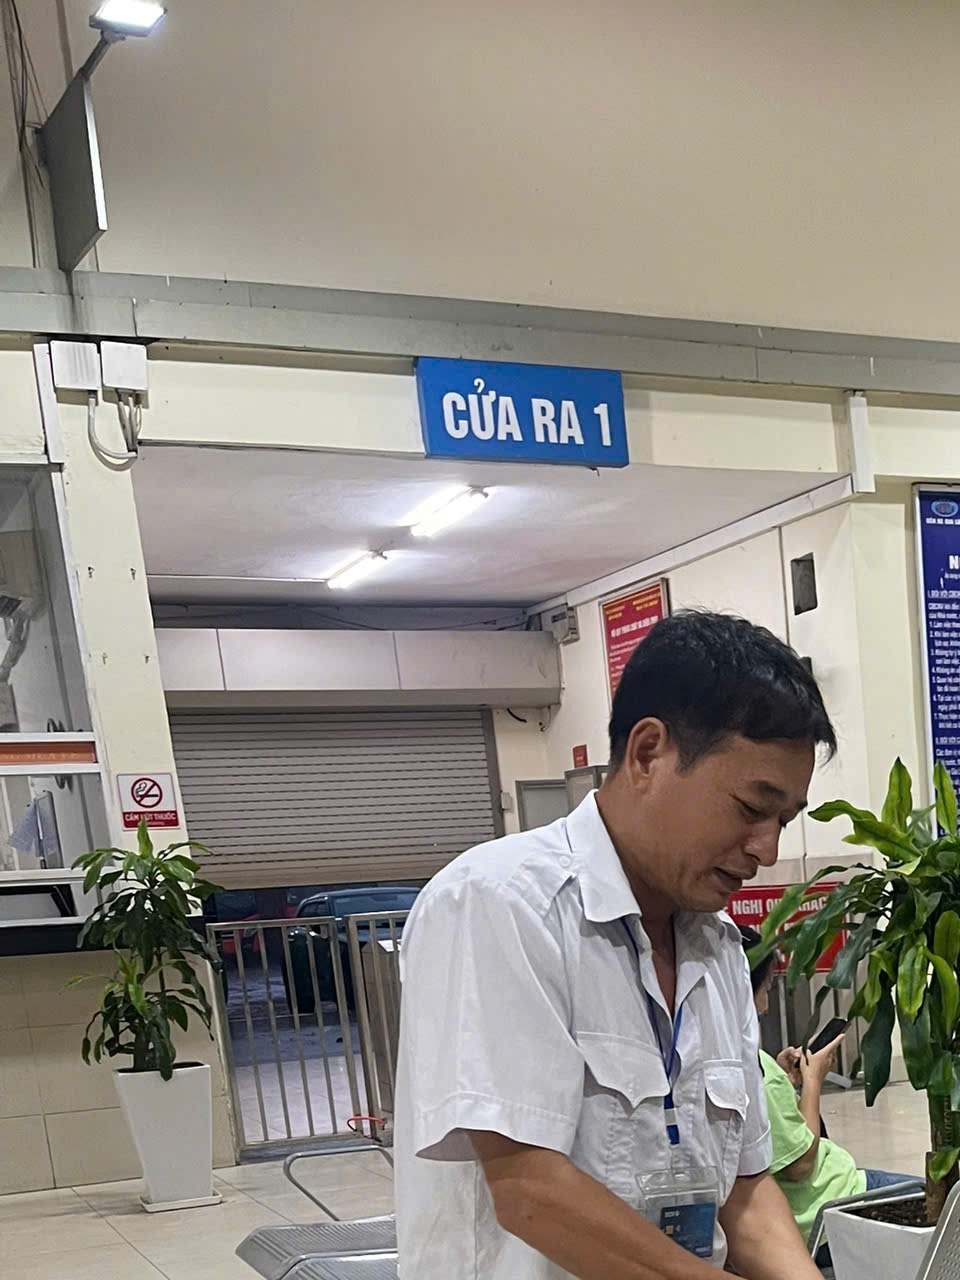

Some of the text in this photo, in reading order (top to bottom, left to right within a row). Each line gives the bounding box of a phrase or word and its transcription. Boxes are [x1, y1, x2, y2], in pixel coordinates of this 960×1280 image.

[442, 377, 612, 446] CỬA RA 1
[732, 898, 763, 917] NGHỊ
